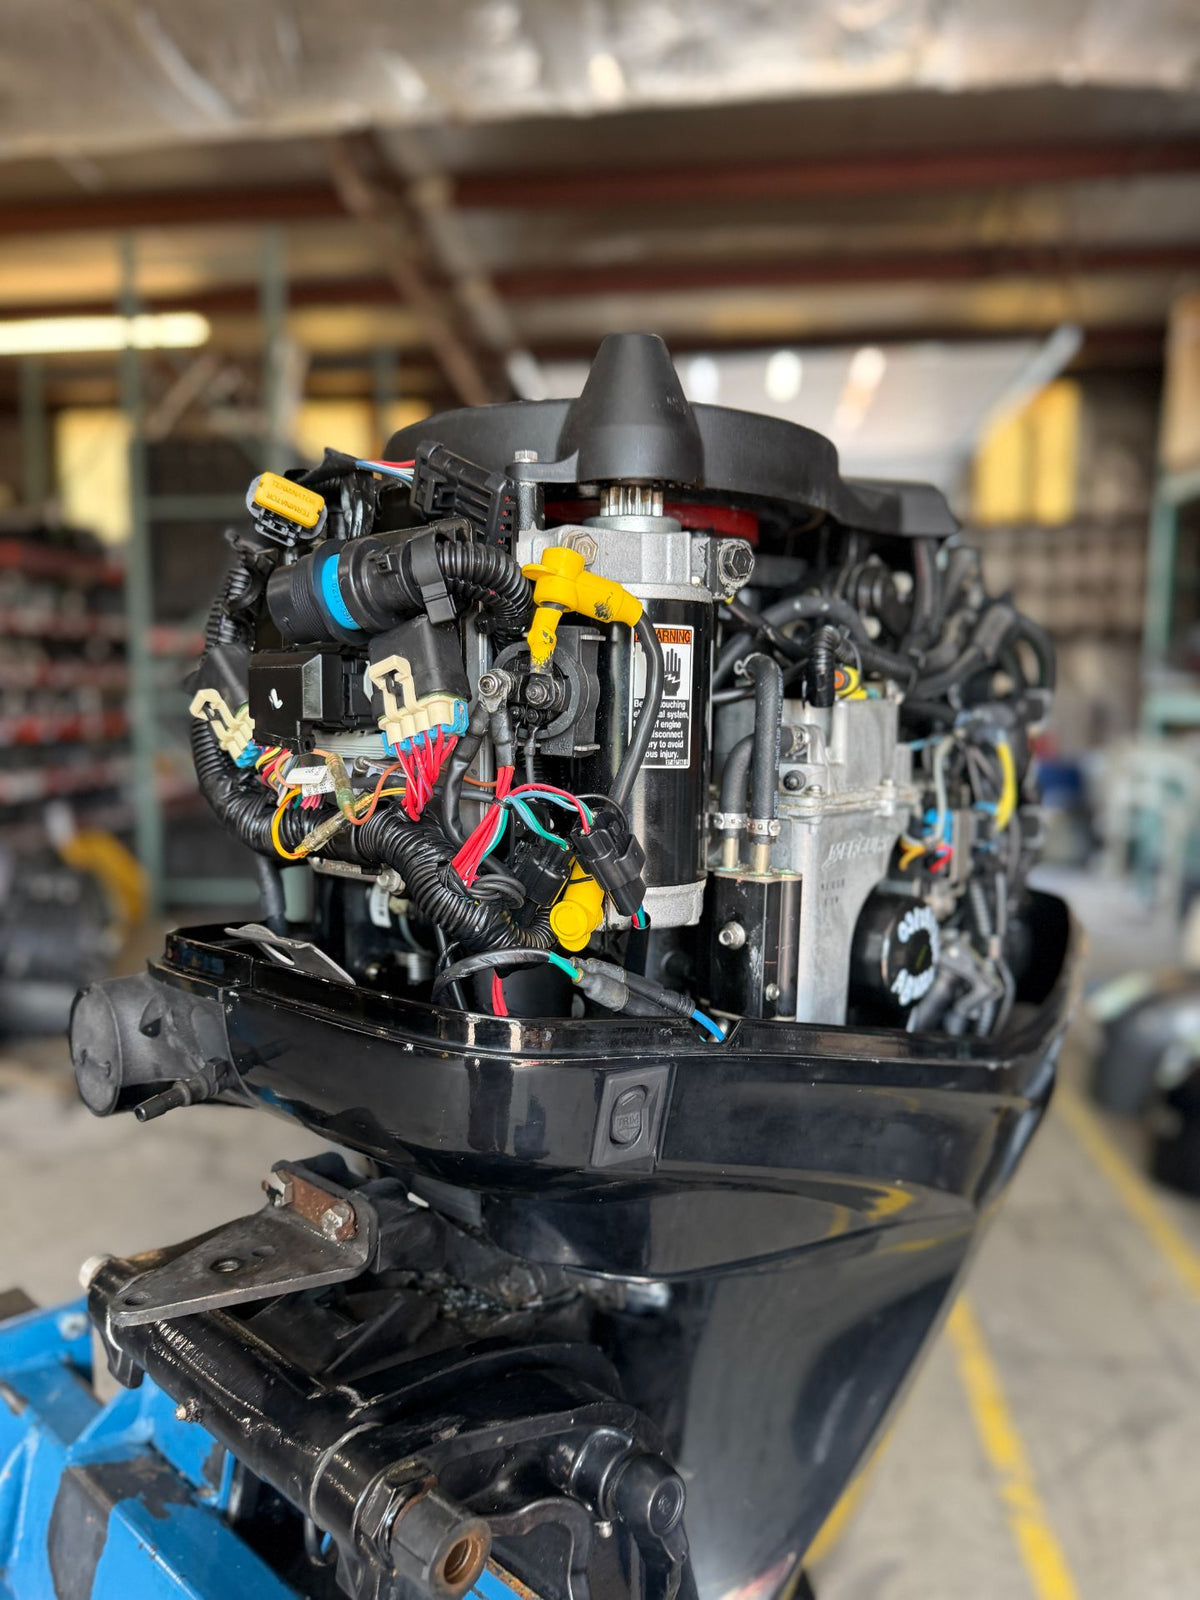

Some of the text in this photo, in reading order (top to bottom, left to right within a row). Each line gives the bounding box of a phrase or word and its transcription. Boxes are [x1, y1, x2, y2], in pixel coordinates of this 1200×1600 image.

[655, 629, 691, 643] ARNING
[660, 700, 686, 711] ouching
[660, 720, 682, 730] engine
[651, 730, 684, 739] isconnect
[659, 740, 667, 748] to
[667, 740, 684, 748] avoid
[659, 749, 679, 759] injury.
